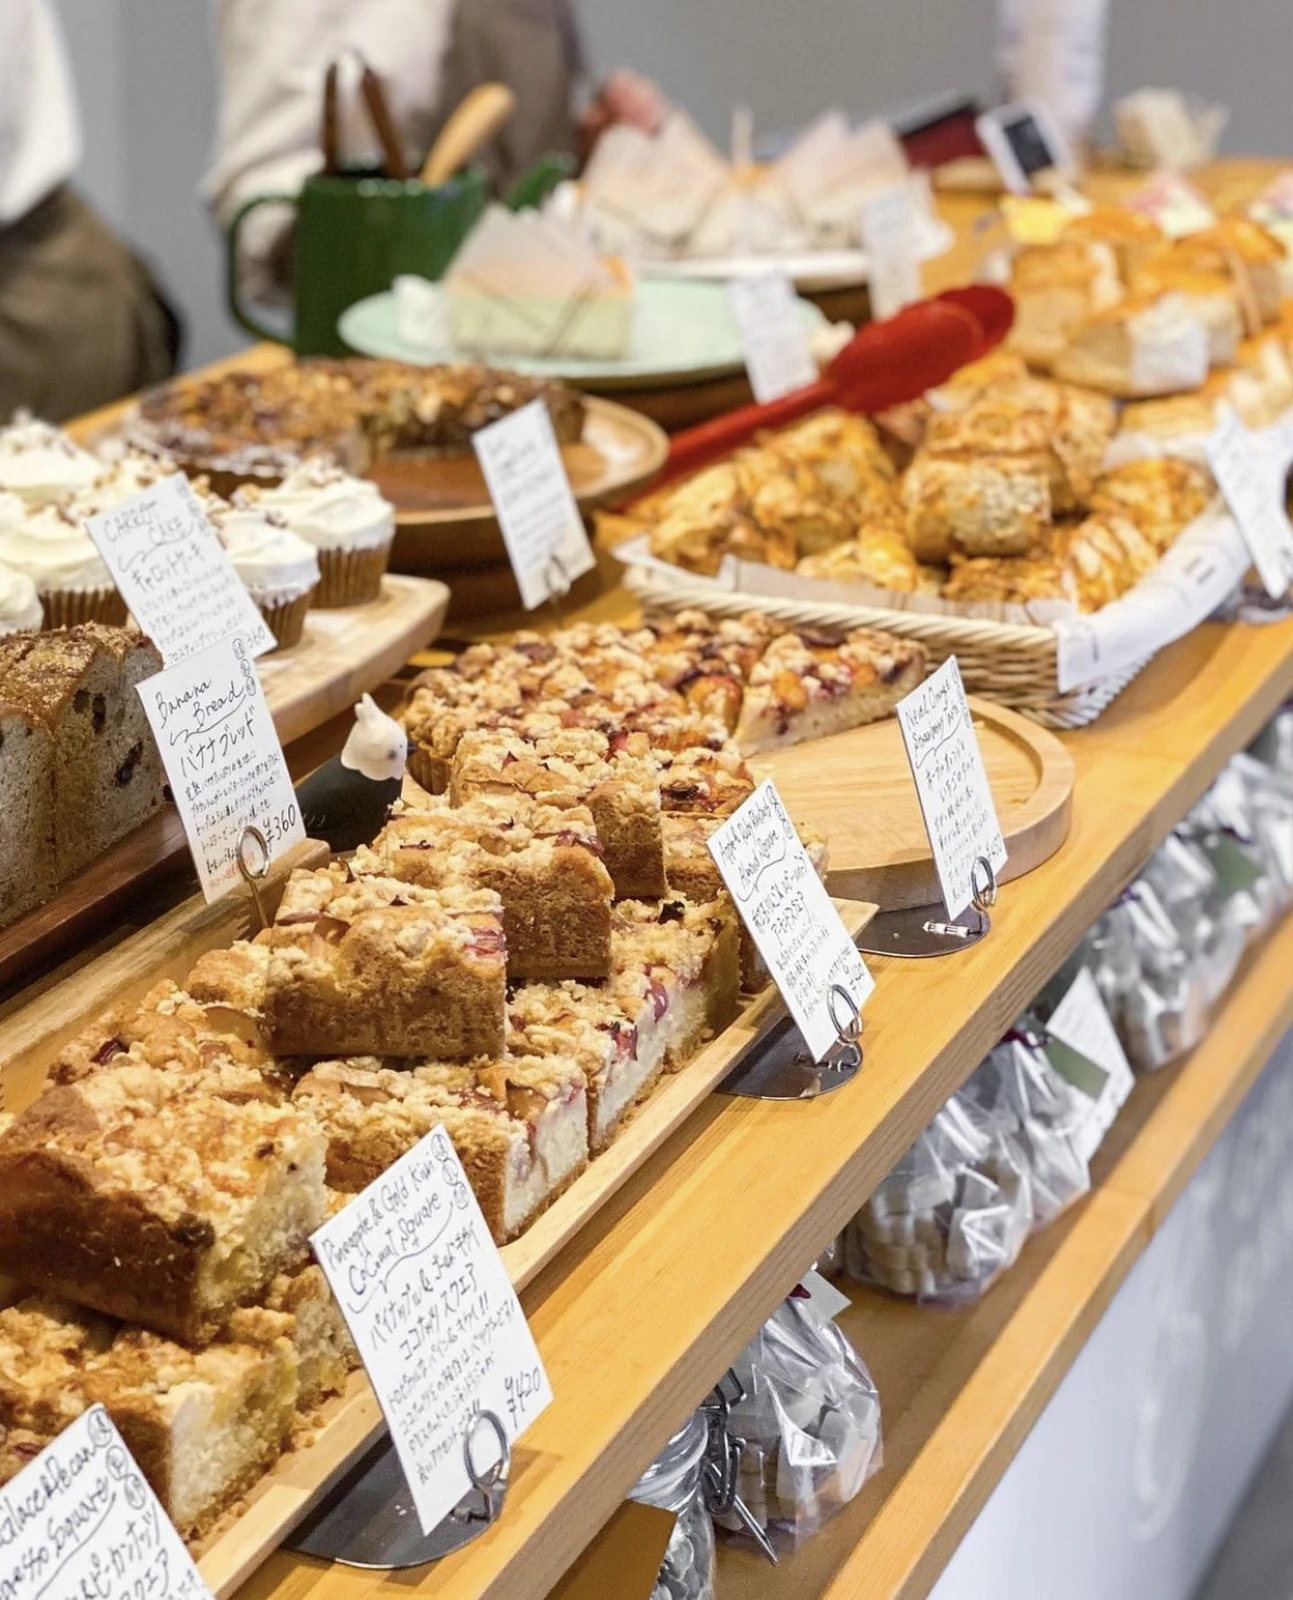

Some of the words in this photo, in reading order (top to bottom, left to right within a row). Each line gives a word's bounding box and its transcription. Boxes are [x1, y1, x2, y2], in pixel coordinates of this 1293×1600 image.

[103, 499, 159, 543] CARROT
[147, 517, 185, 547] CAKE
[155, 679, 214, 728] Banana
[192, 680, 246, 728] Bread
[180, 704, 255, 778] バナナブレッド
[262, 803, 296, 853] ¥360
[320, 1211, 374, 1271] Pineapple
[380, 1175, 409, 1215] Gold
[407, 1151, 435, 1192] Kiwi
[398, 1192, 442, 1255] Square
[504, 1366, 541, 1431] ¥420
